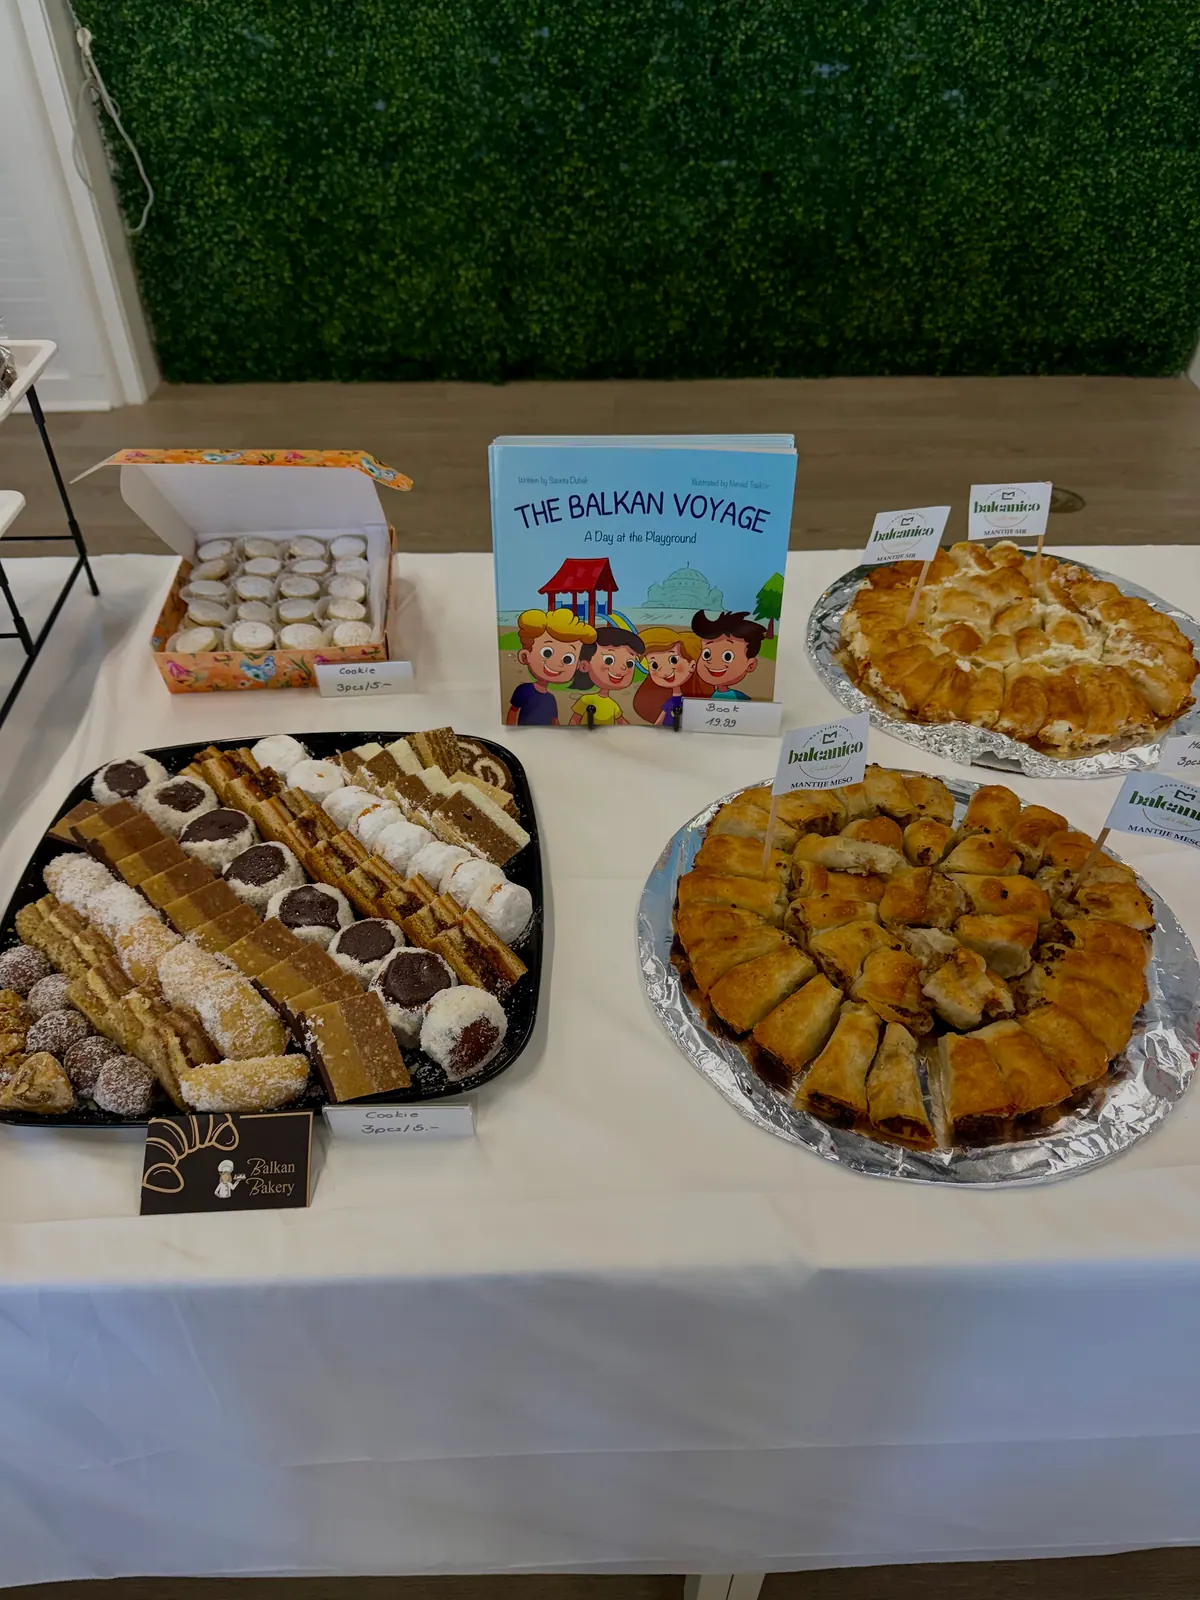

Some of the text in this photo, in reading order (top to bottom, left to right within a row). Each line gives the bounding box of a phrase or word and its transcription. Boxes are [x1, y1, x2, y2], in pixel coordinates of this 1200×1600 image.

[514, 490, 771, 534] THE BALKAN VOYAGE
[974, 500, 1040, 513] balcanico
[584, 530, 697, 546] A Day at the Playground
[872, 525, 934, 542] balcanico
[705, 703, 740, 713] Book
[705, 717, 737, 728] 19.99
[787, 741, 864, 765] balcanico
[790, 776, 853, 789] MANTIJE MESO
[1127, 824, 1173, 838] MANTIJE
[365, 1111, 419, 1119] Cookie
[246, 1157, 296, 1176] Balkan
[245, 1177, 296, 1197] Bakery
